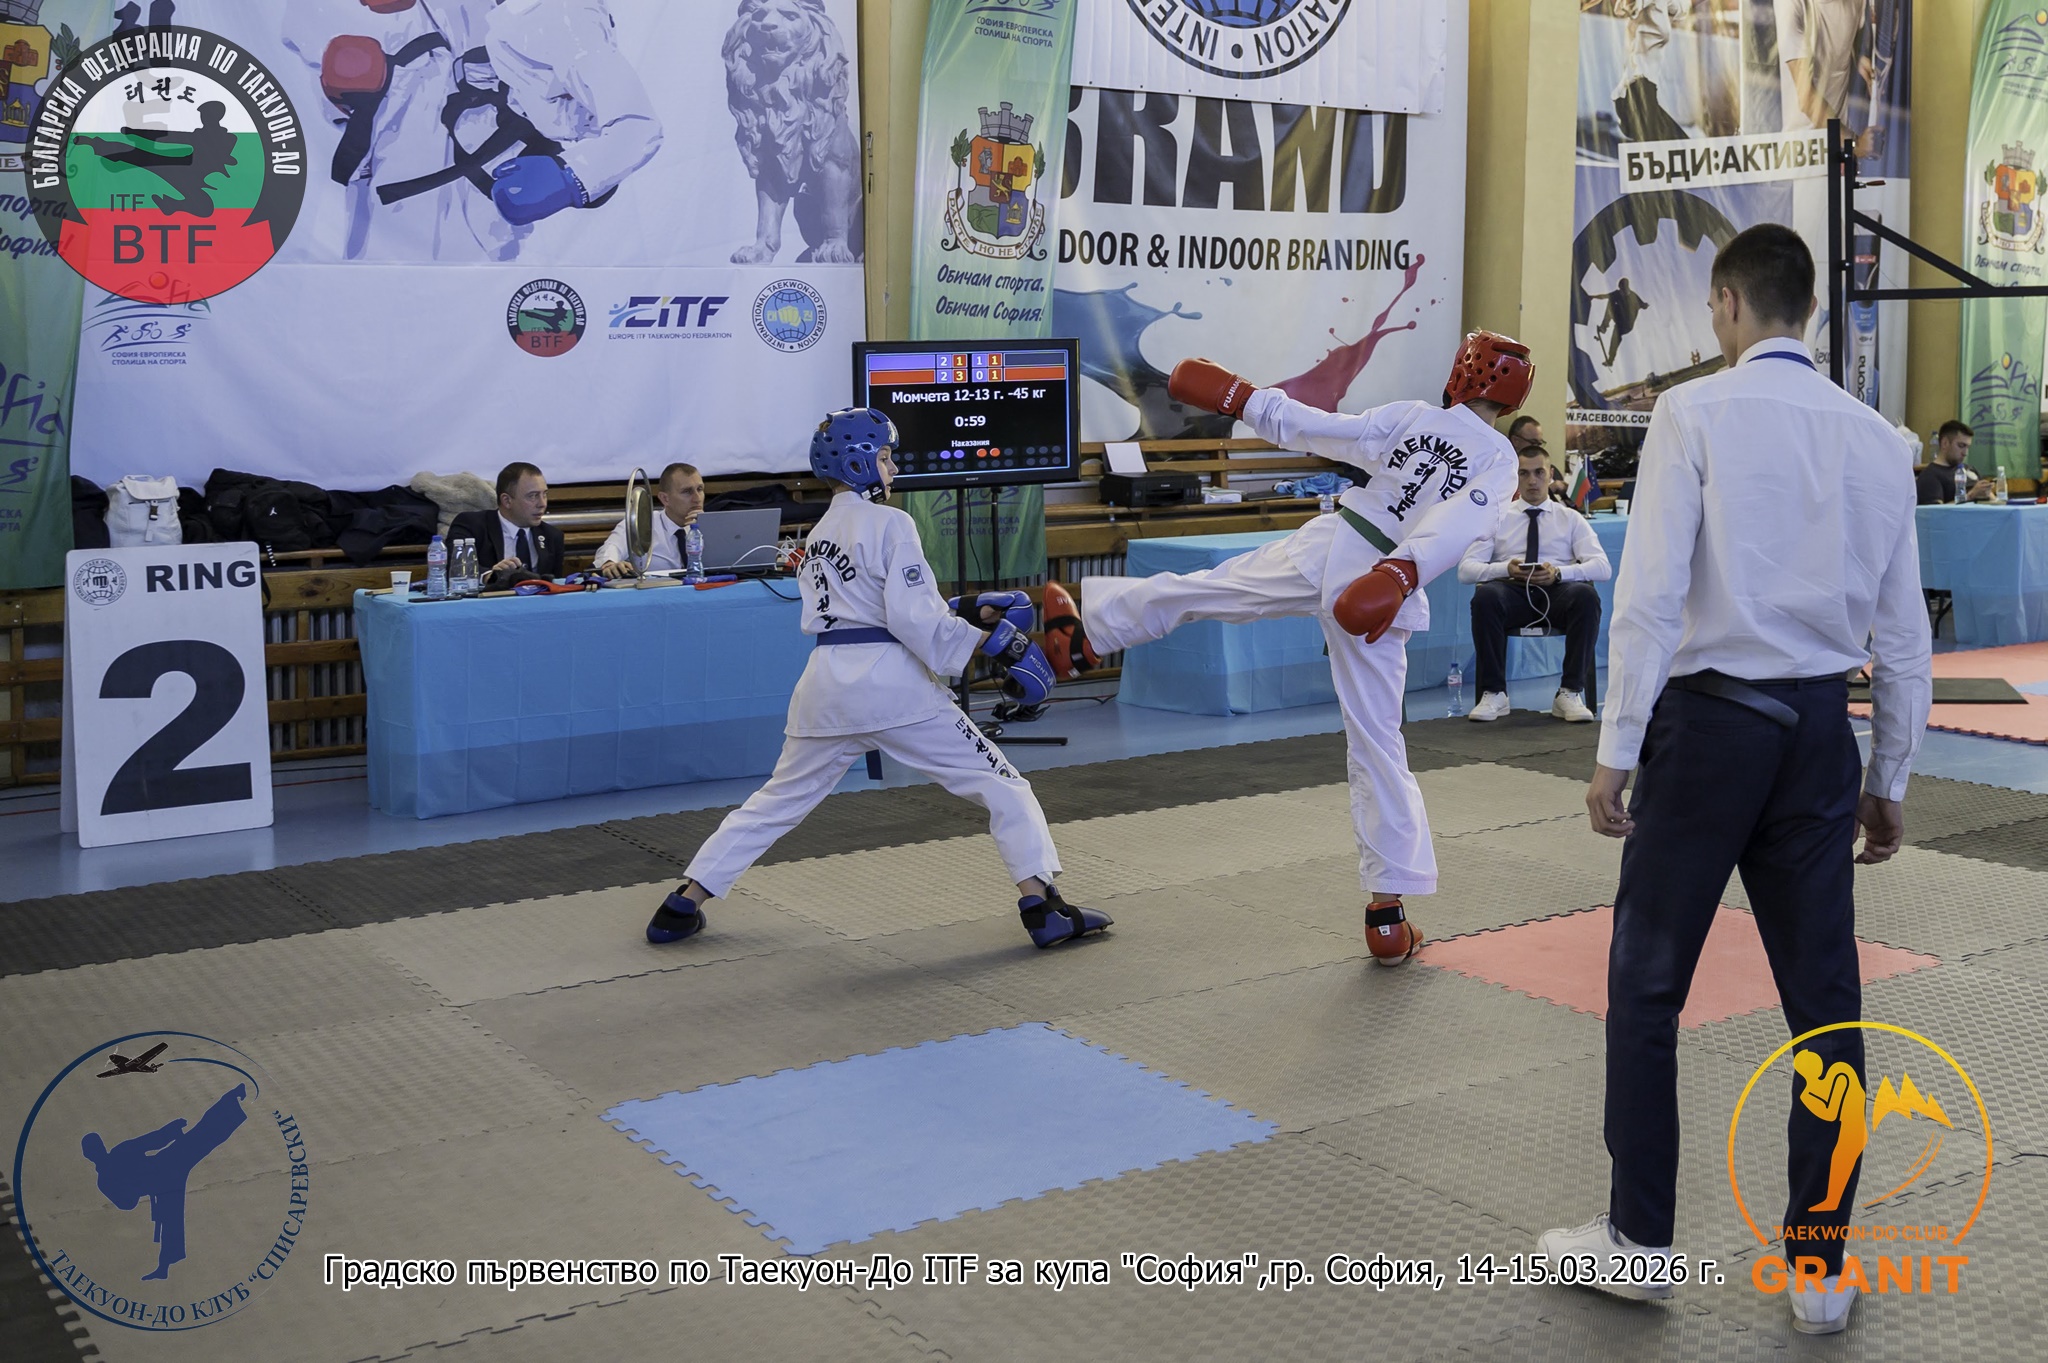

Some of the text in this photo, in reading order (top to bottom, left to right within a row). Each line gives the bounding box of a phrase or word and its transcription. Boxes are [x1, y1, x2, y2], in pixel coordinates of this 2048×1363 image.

[975, 26, 1053, 48] СТОЛИЦА НА СПОРТА
[979, 245, 995, 255] НО
[998, 248, 1014, 256] НЕ
[1058, 228, 1411, 272] DOOR & INDOOR BRANDING
[937, 263, 993, 288] Обичам
[754, 281, 825, 350] INTERNATIONAL TAEKWON-DO FEDERATION
[935, 295, 1046, 326] Обичам София!
[531, 336, 563, 348] BTF
[940, 355, 998, 367] 2 1 1 1
[940, 370, 998, 381] 2 3 0 1
[891, 387, 1046, 404] Момчета 12-13 г. -45 кг
[954, 415, 987, 428] 0:59
[951, 439, 990, 448] Наказания
[146, 560, 257, 593] RING
[99, 639, 253, 816] 2
